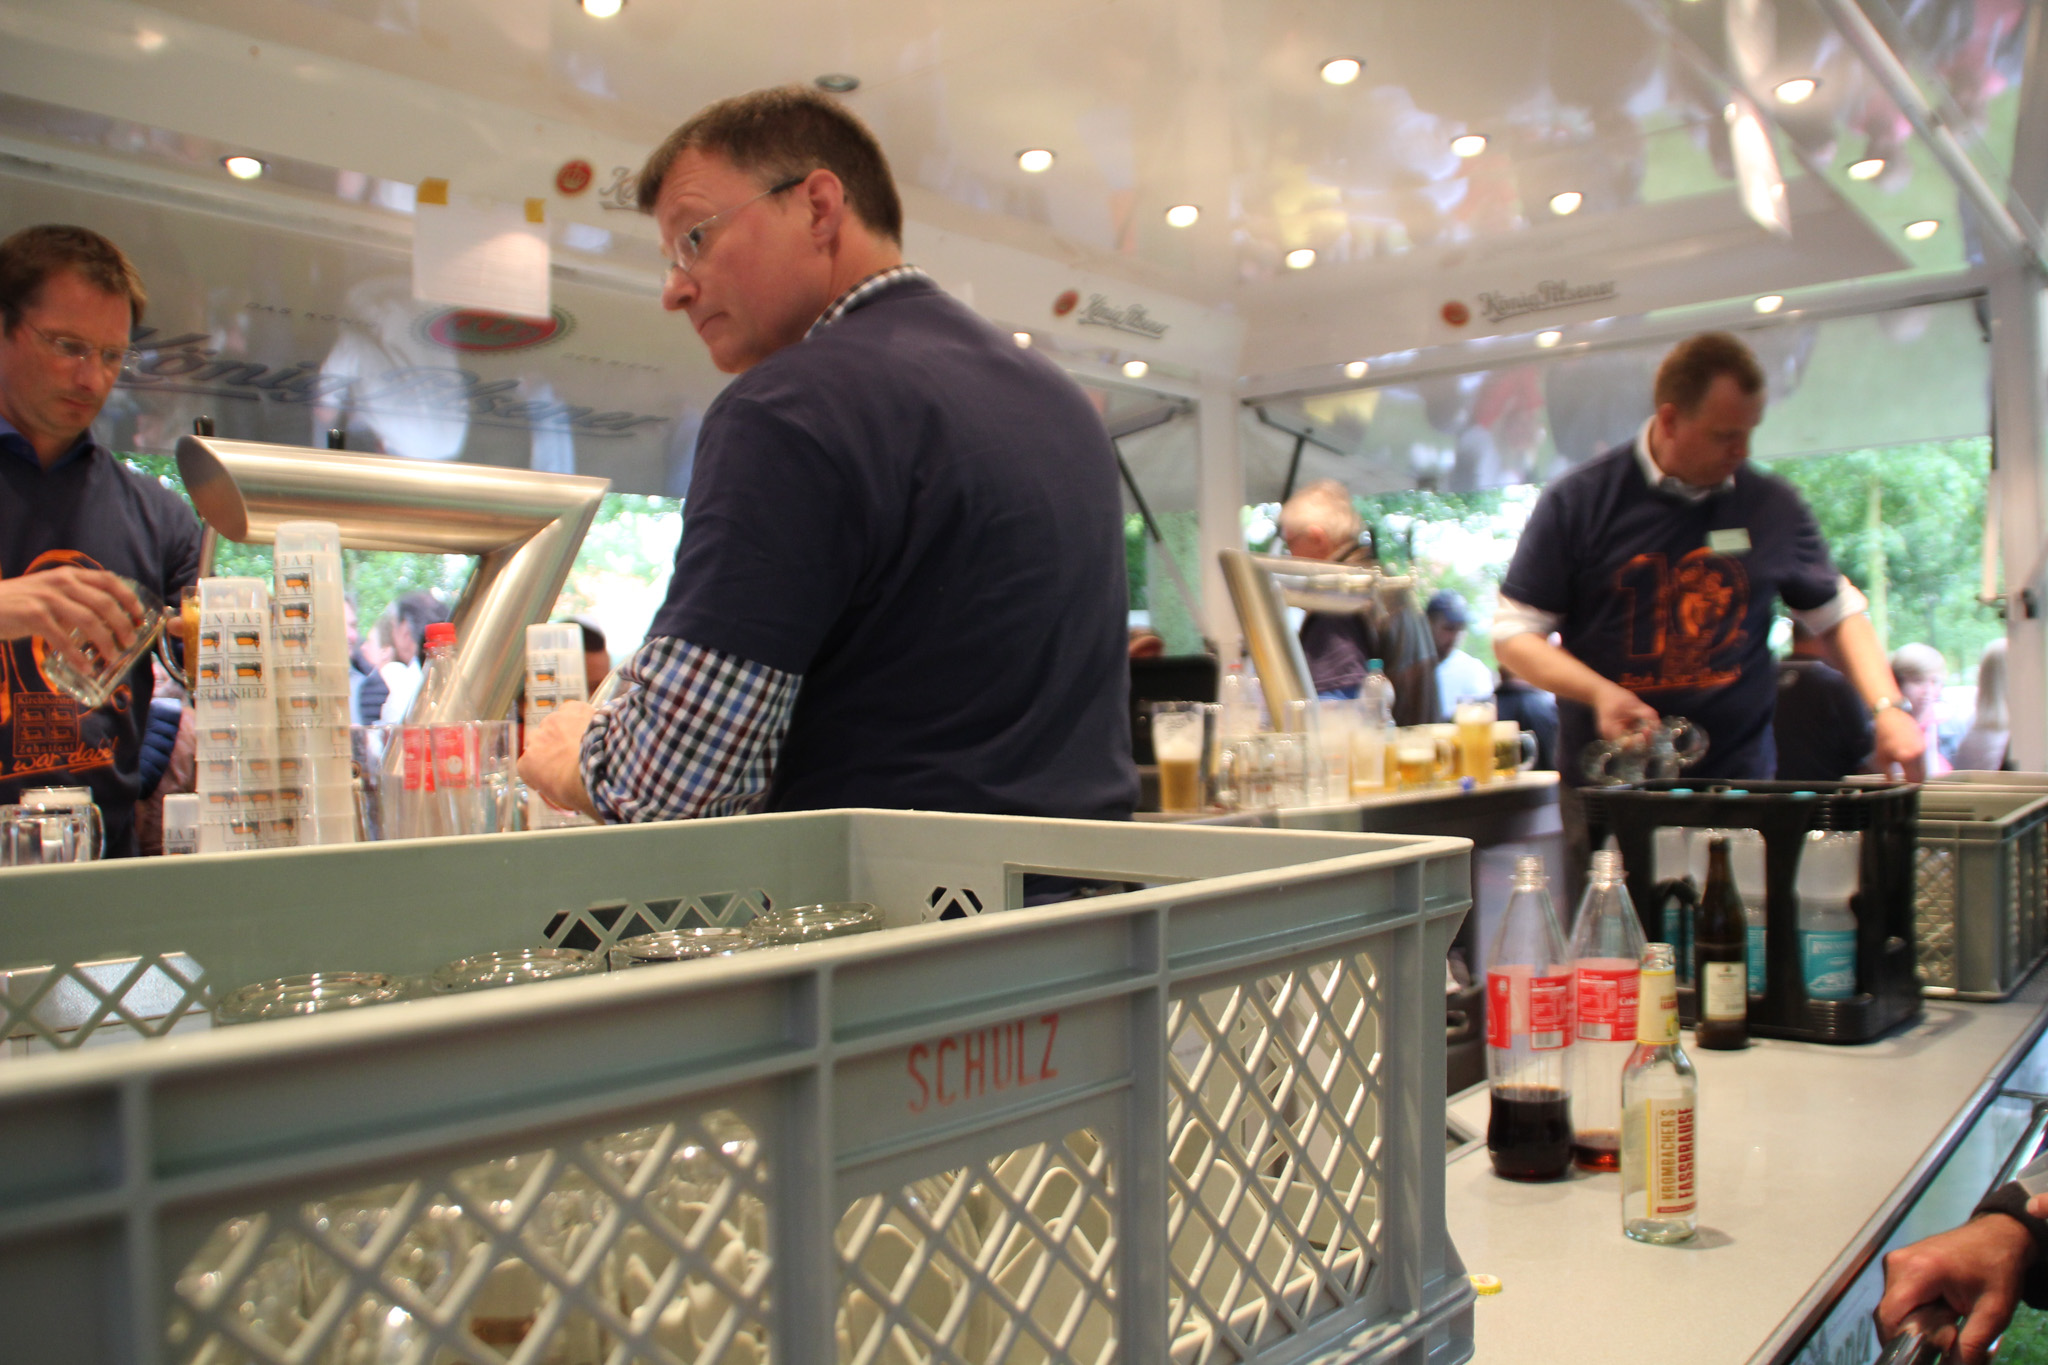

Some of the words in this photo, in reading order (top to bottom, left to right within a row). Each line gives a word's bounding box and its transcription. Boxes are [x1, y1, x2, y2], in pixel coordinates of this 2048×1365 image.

[906, 1012, 1060, 1114] SCHULZ
[1660, 1108, 1676, 1200] KROMBACHER'S
[1677, 1105, 1696, 1199] FASSBRAUSE
